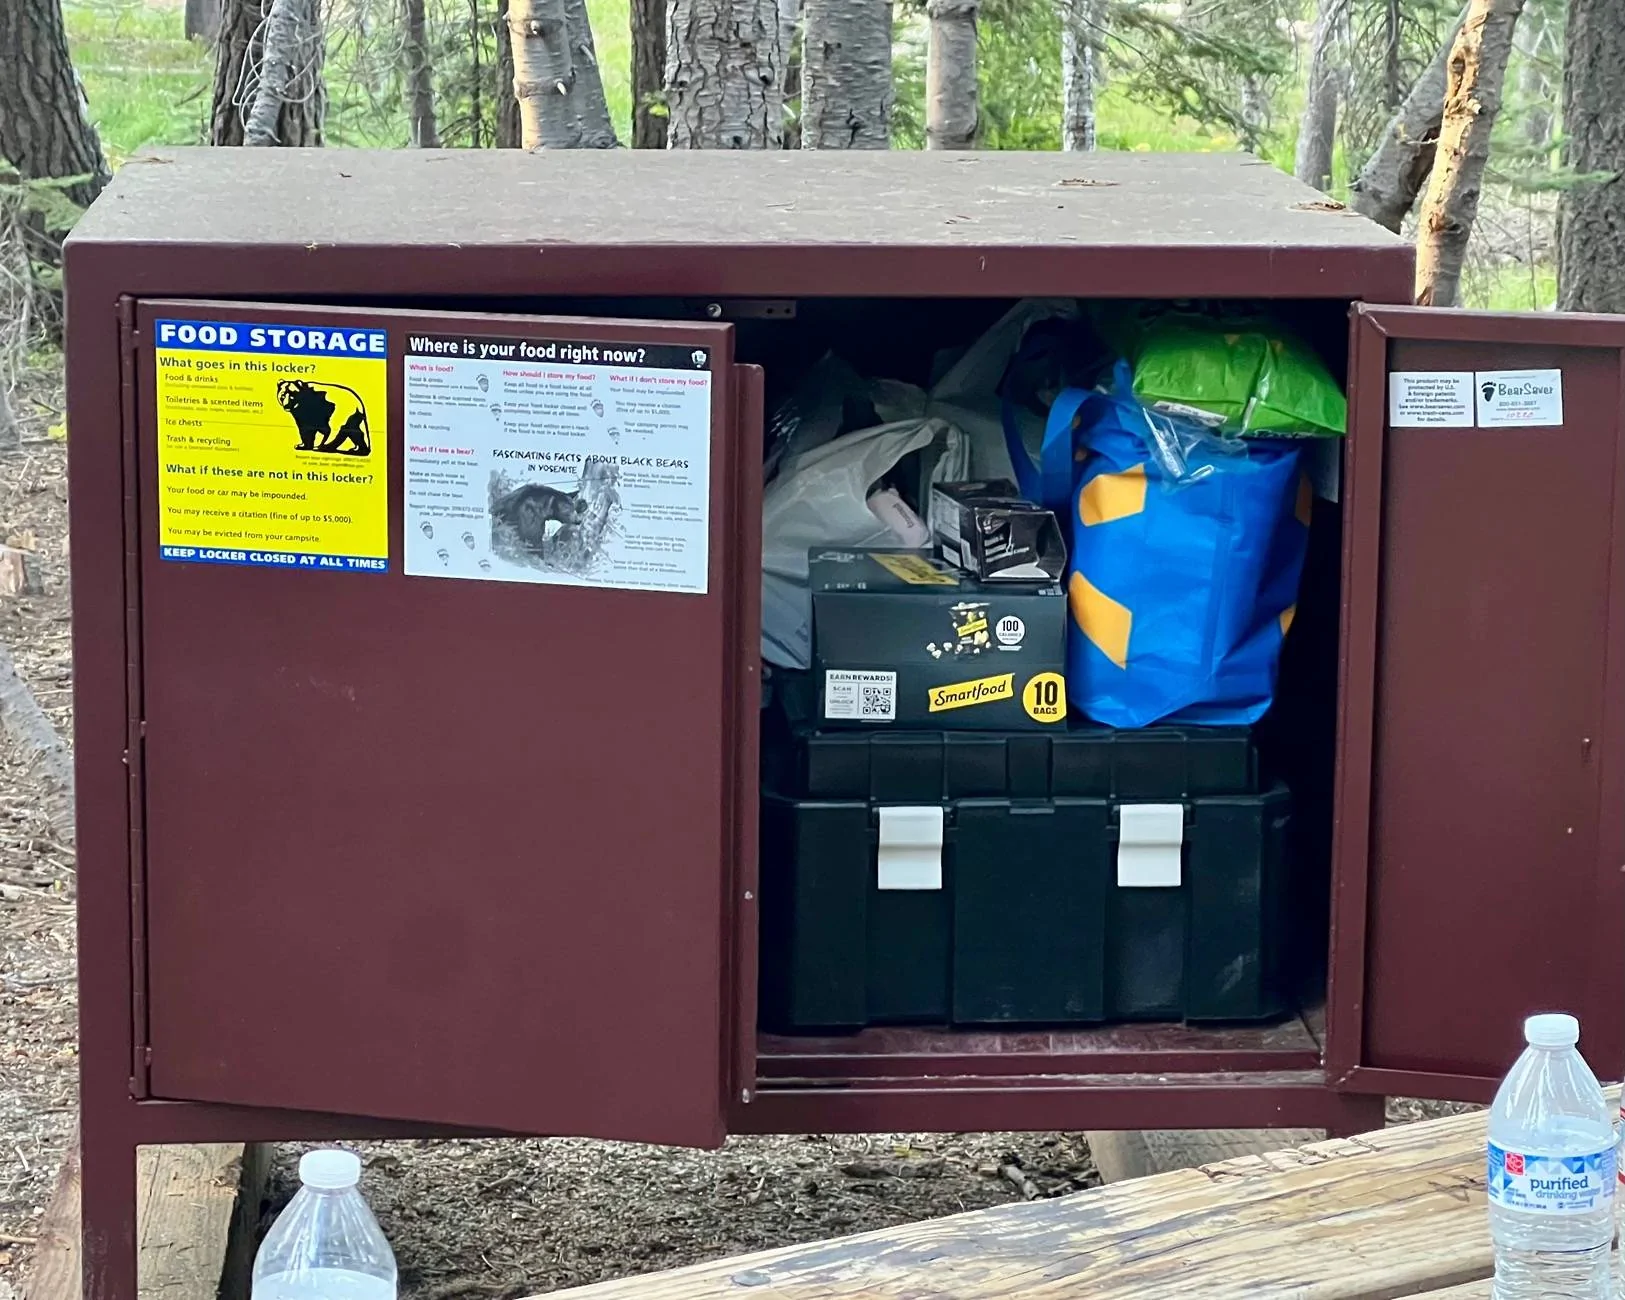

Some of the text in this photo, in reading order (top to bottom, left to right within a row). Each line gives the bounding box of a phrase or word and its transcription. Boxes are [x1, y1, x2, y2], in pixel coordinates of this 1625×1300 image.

[160, 324, 385, 353] FOOD STORAGE
[409, 337, 645, 364] Where is your food right now?
[159, 356, 316, 374] What goes in this locker?
[165, 373, 218, 383] Food & drinks
[639, 376, 657, 384] don't
[1498, 382, 1554, 396] BearSaver
[165, 395, 264, 408] Toiletries & scented items
[165, 418, 202, 427] Ice chests
[167, 434, 186, 443] Trash
[197, 437, 231, 446] recycling
[456, 447, 475, 455] bear?
[492, 449, 689, 469] FASCINATING FACTS ABOUT BLACK BEARS
[166, 464, 373, 484] What if these are not in this locker?
[527, 463, 577, 475] IN YOSEMITE
[167, 486, 185, 494] Your
[186, 486, 205, 495] food
[230, 490, 247, 498] may
[249, 490, 259, 498] be
[261, 492, 308, 500] impounded.
[167, 506, 181, 514] You
[184, 508, 200, 517] may
[202, 508, 230, 516] receive
[238, 511, 268, 519] citation
[269, 512, 288, 521] (fine
[300, 515, 311, 523] up
[313, 514, 321, 522] to
[168, 527, 182, 535] You
[184, 529, 201, 537] may
[214, 530, 242, 538] evicted
[244, 531, 263, 539] from
[163, 547, 385, 569] KEEP LOCKER CLOSED AT ALL TIMES
[1002, 620, 1019, 632] 100
[934, 680, 1007, 707] Smartfood
[1034, 680, 1058, 707] 10
[1033, 707, 1058, 715] BAGS
[1530, 1175, 1589, 1191] purified
[1535, 1190, 1577, 1202] drinking
